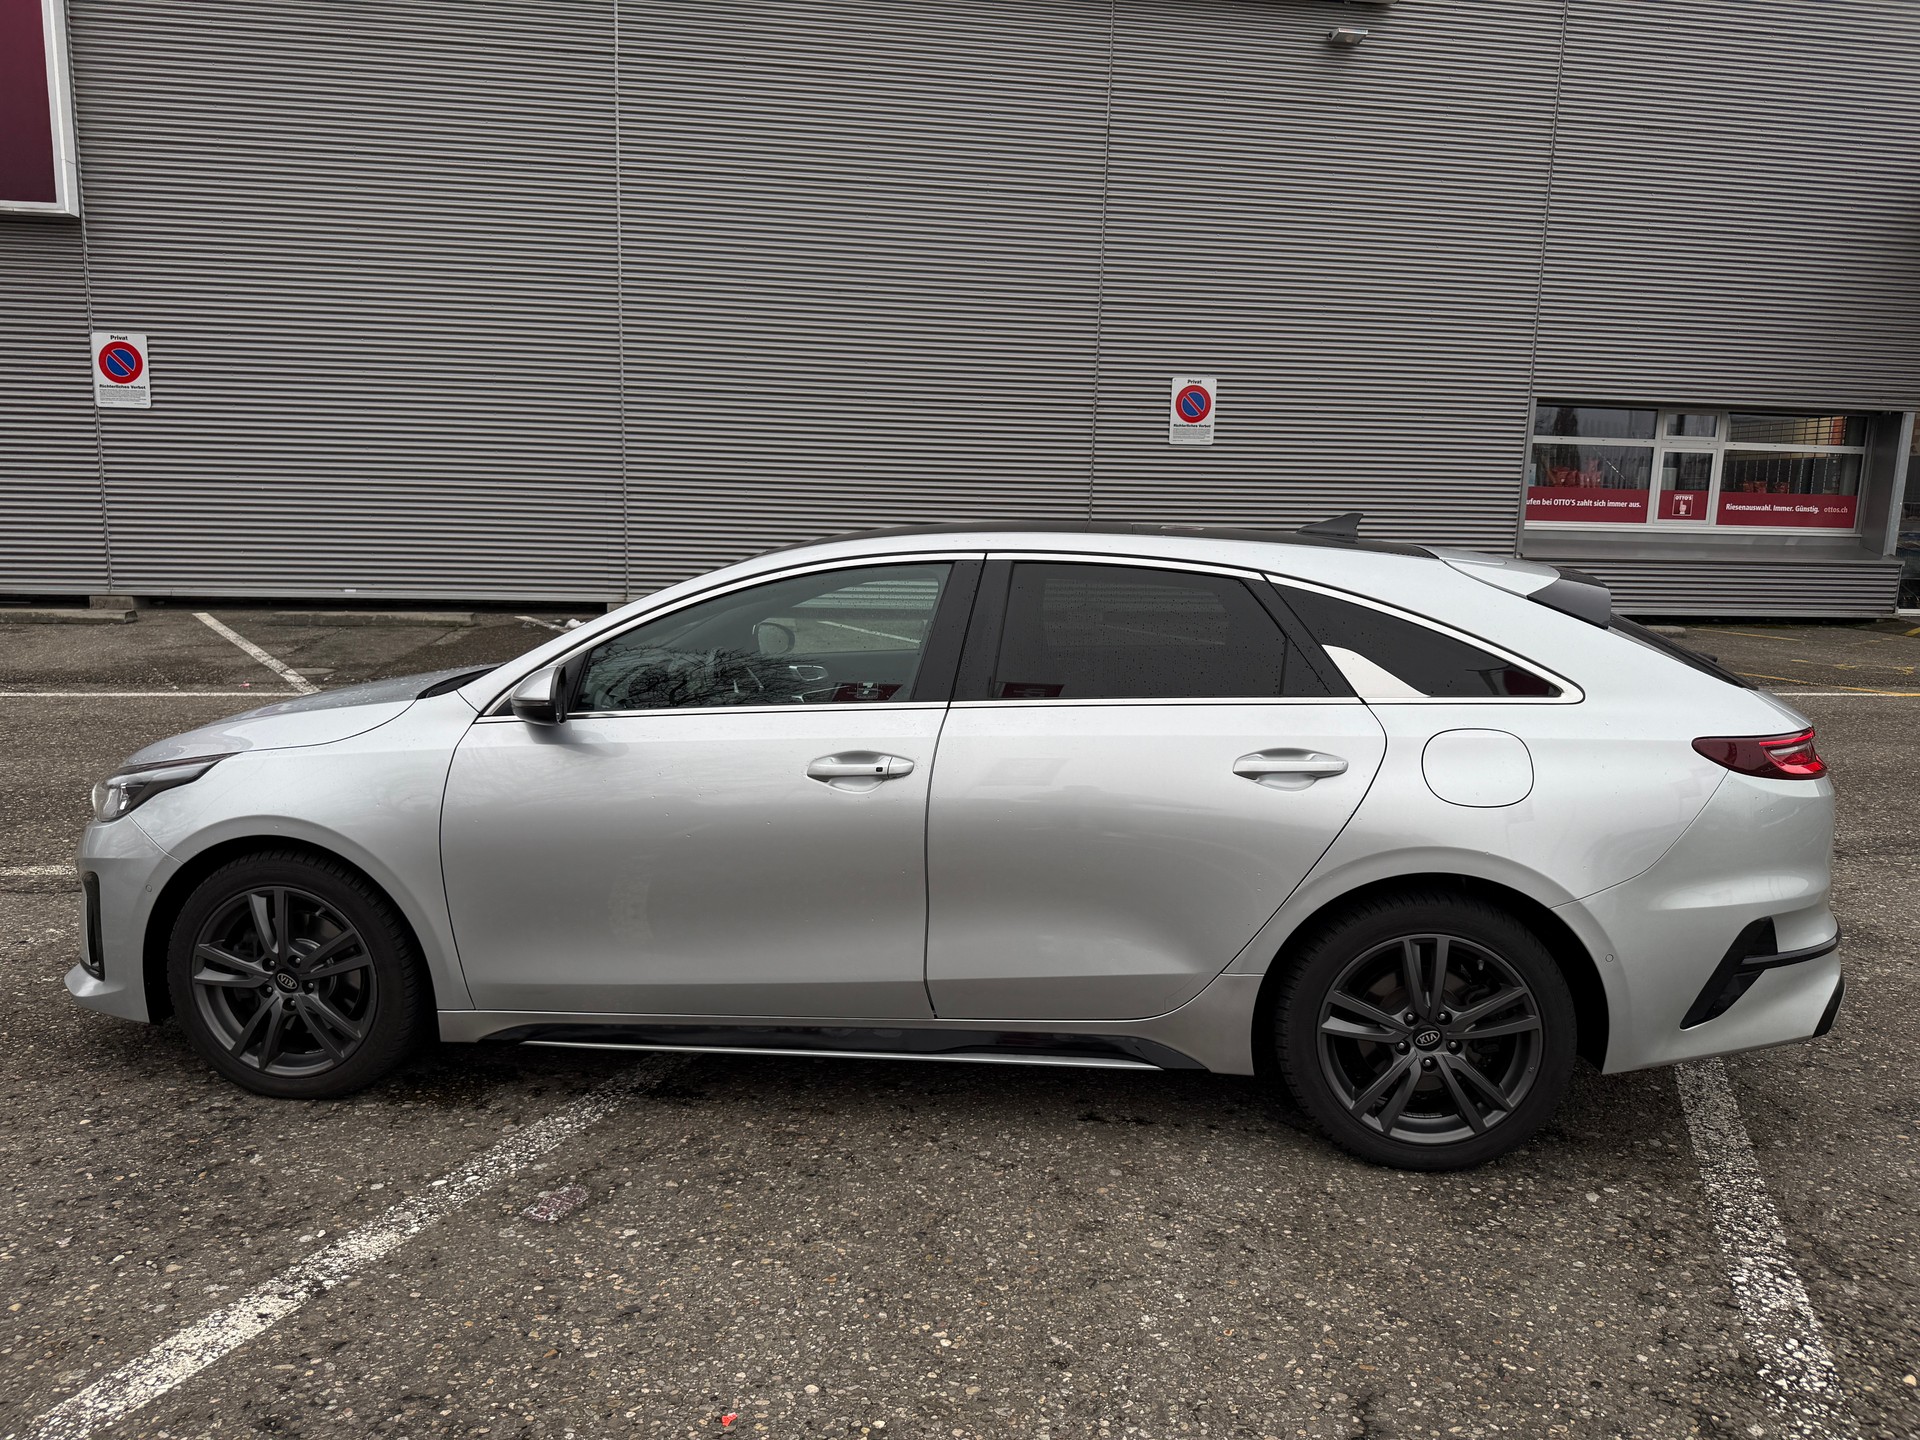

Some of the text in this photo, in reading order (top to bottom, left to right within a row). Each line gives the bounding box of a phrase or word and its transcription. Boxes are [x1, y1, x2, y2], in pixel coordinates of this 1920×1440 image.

[1593, 499, 1606, 507] sich
[1726, 503, 1772, 511] Riesenauswahl.
[1795, 505, 1819, 514] Günstig.
[1419, 1033, 1437, 1044] KIA
